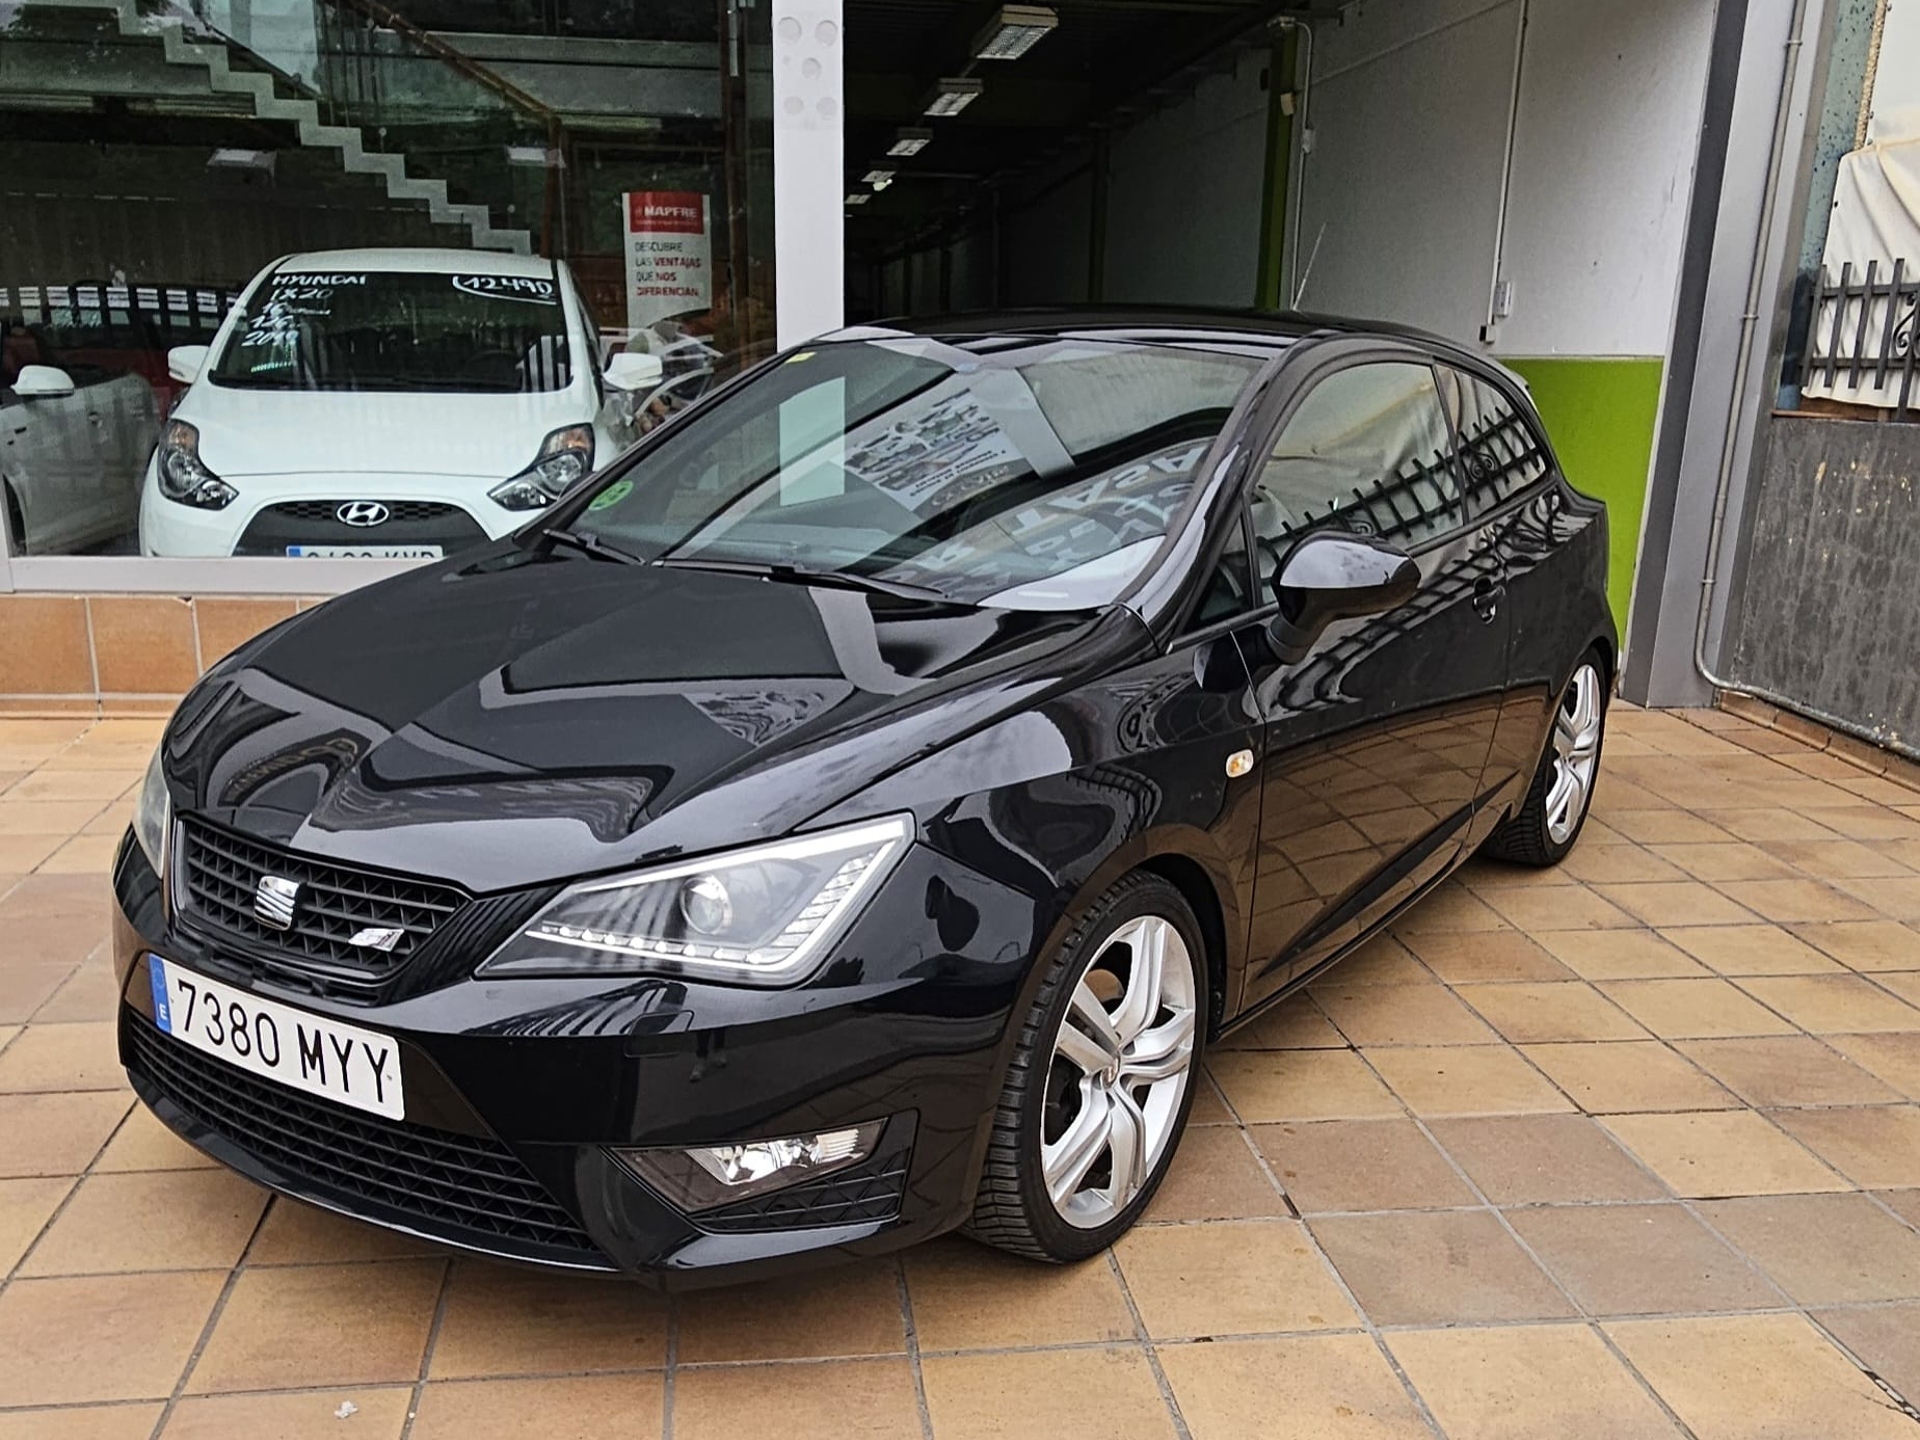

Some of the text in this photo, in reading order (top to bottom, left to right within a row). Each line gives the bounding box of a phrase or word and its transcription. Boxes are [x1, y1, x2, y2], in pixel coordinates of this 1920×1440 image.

[644, 206, 698, 218] MAPFRE
[635, 241, 683, 253] DESCUBRE
[635, 257, 701, 269] LAS VENTAJAS
[271, 274, 367, 286] HYUNDAI
[636, 271, 677, 283] QUE NOS
[637, 286, 700, 297] DIFERENCIAN
[158, 1002, 168, 1020] E
[177, 978, 389, 1104] 7380 MYY
